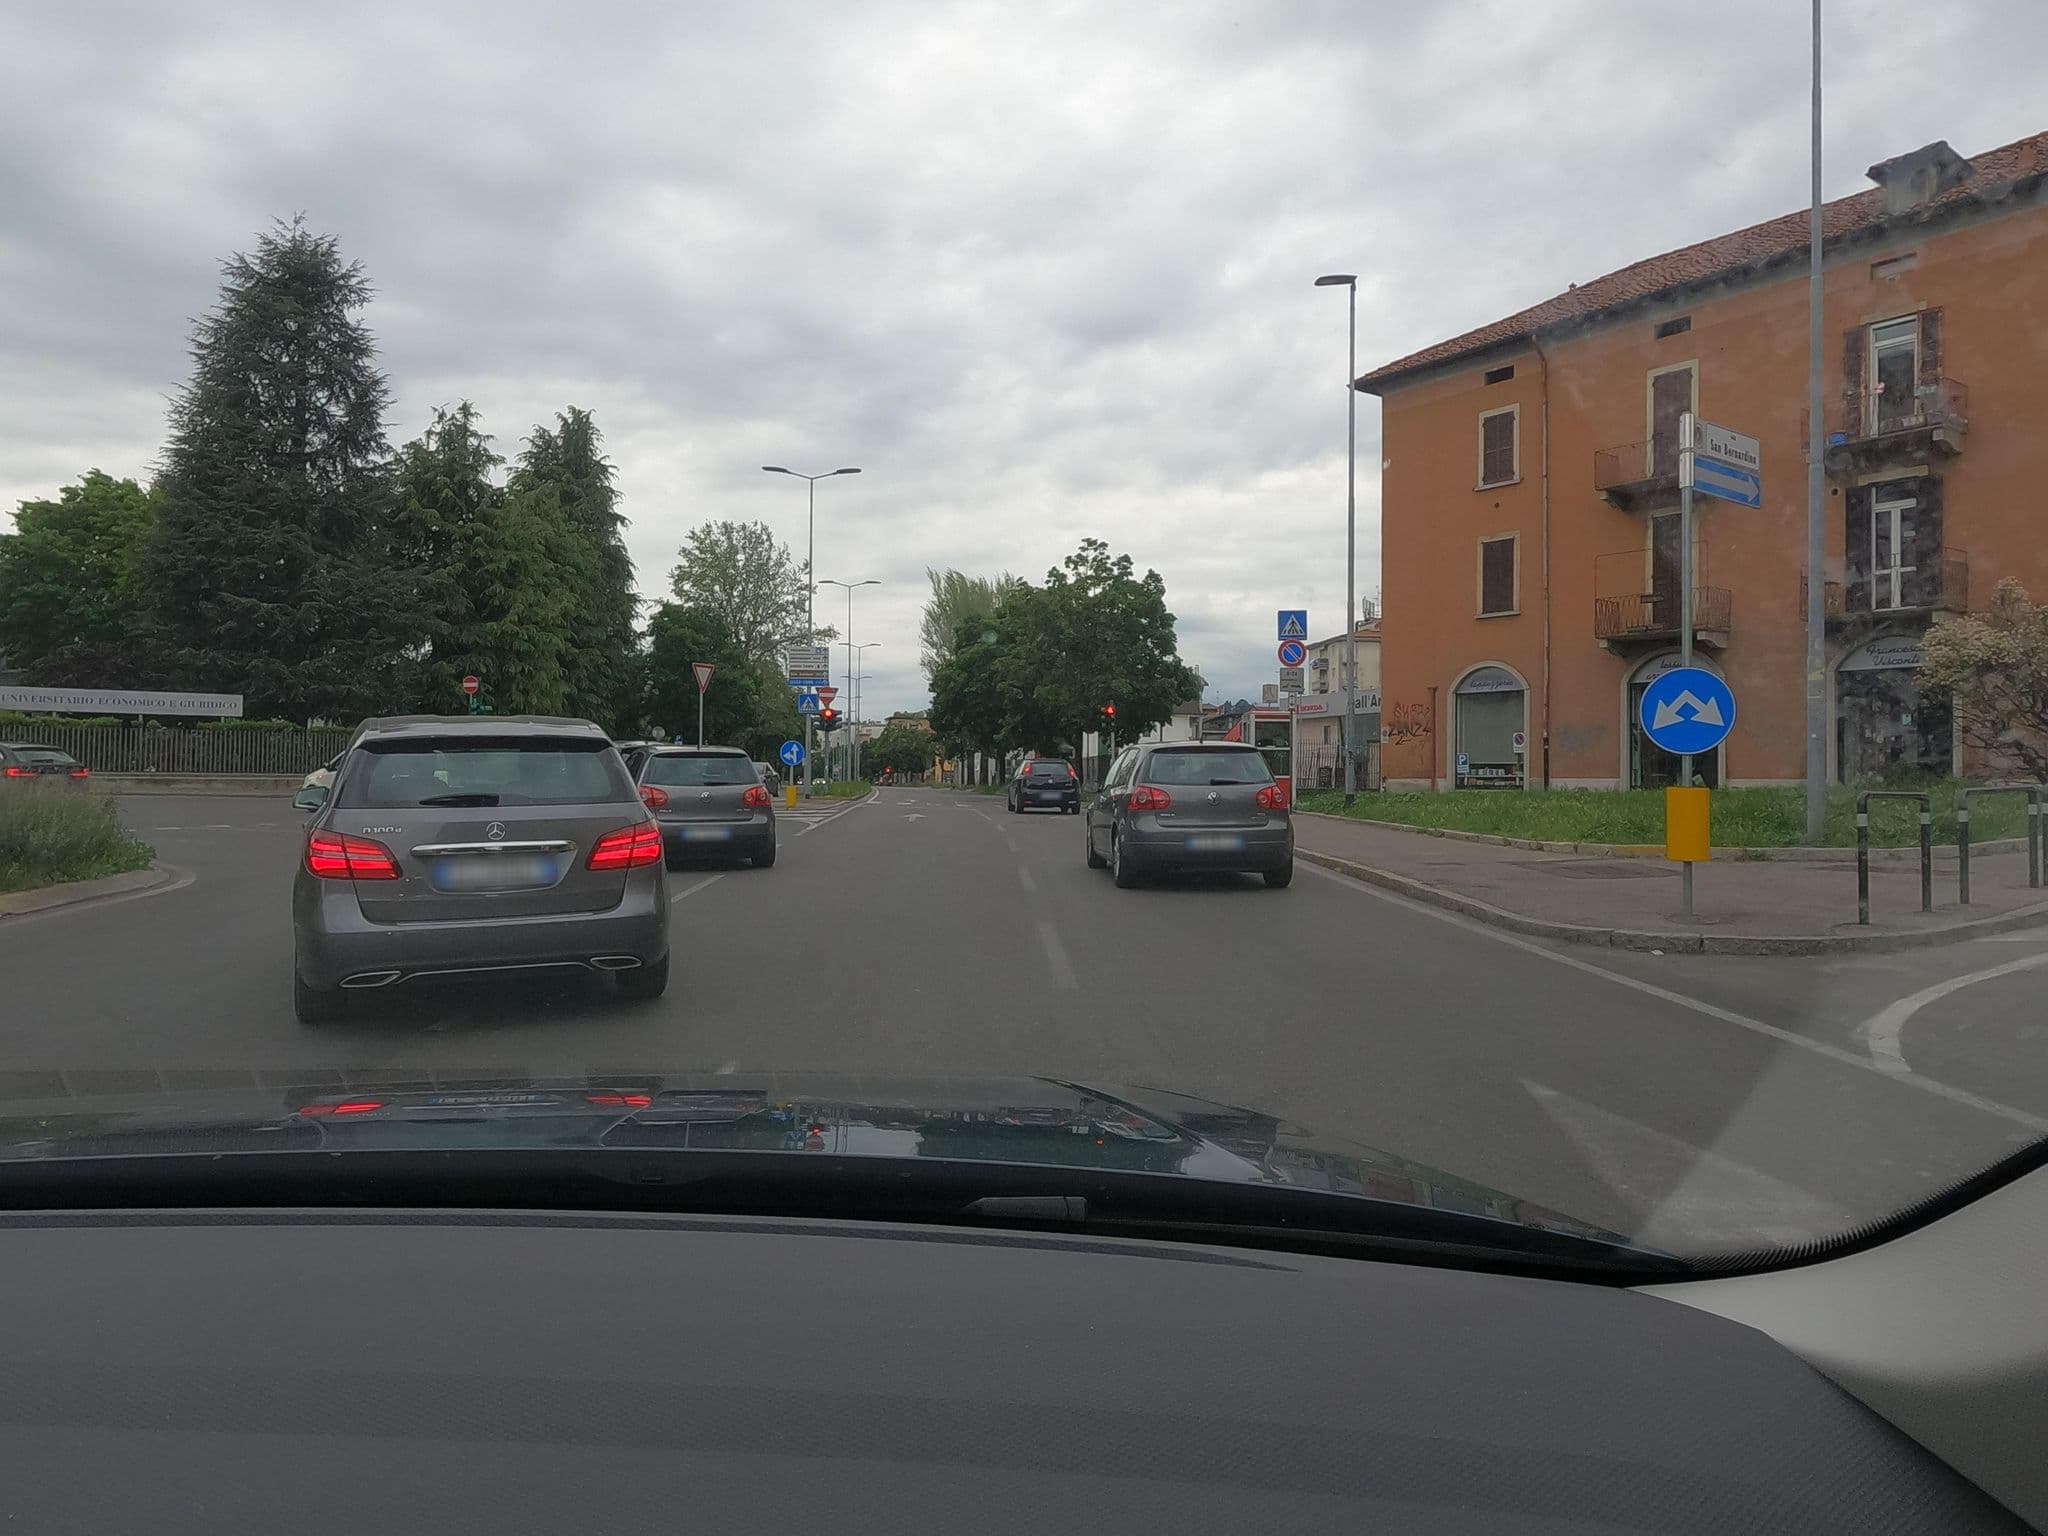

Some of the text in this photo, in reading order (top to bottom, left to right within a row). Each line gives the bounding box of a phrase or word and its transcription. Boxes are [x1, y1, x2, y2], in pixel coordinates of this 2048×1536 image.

[1710, 438, 1757, 465] San Bernardino
[0, 693, 94, 705] UNIVERSITARIO
[98, 696, 166, 707] ECONOMICO
[179, 700, 237, 709] GIURIDICO
